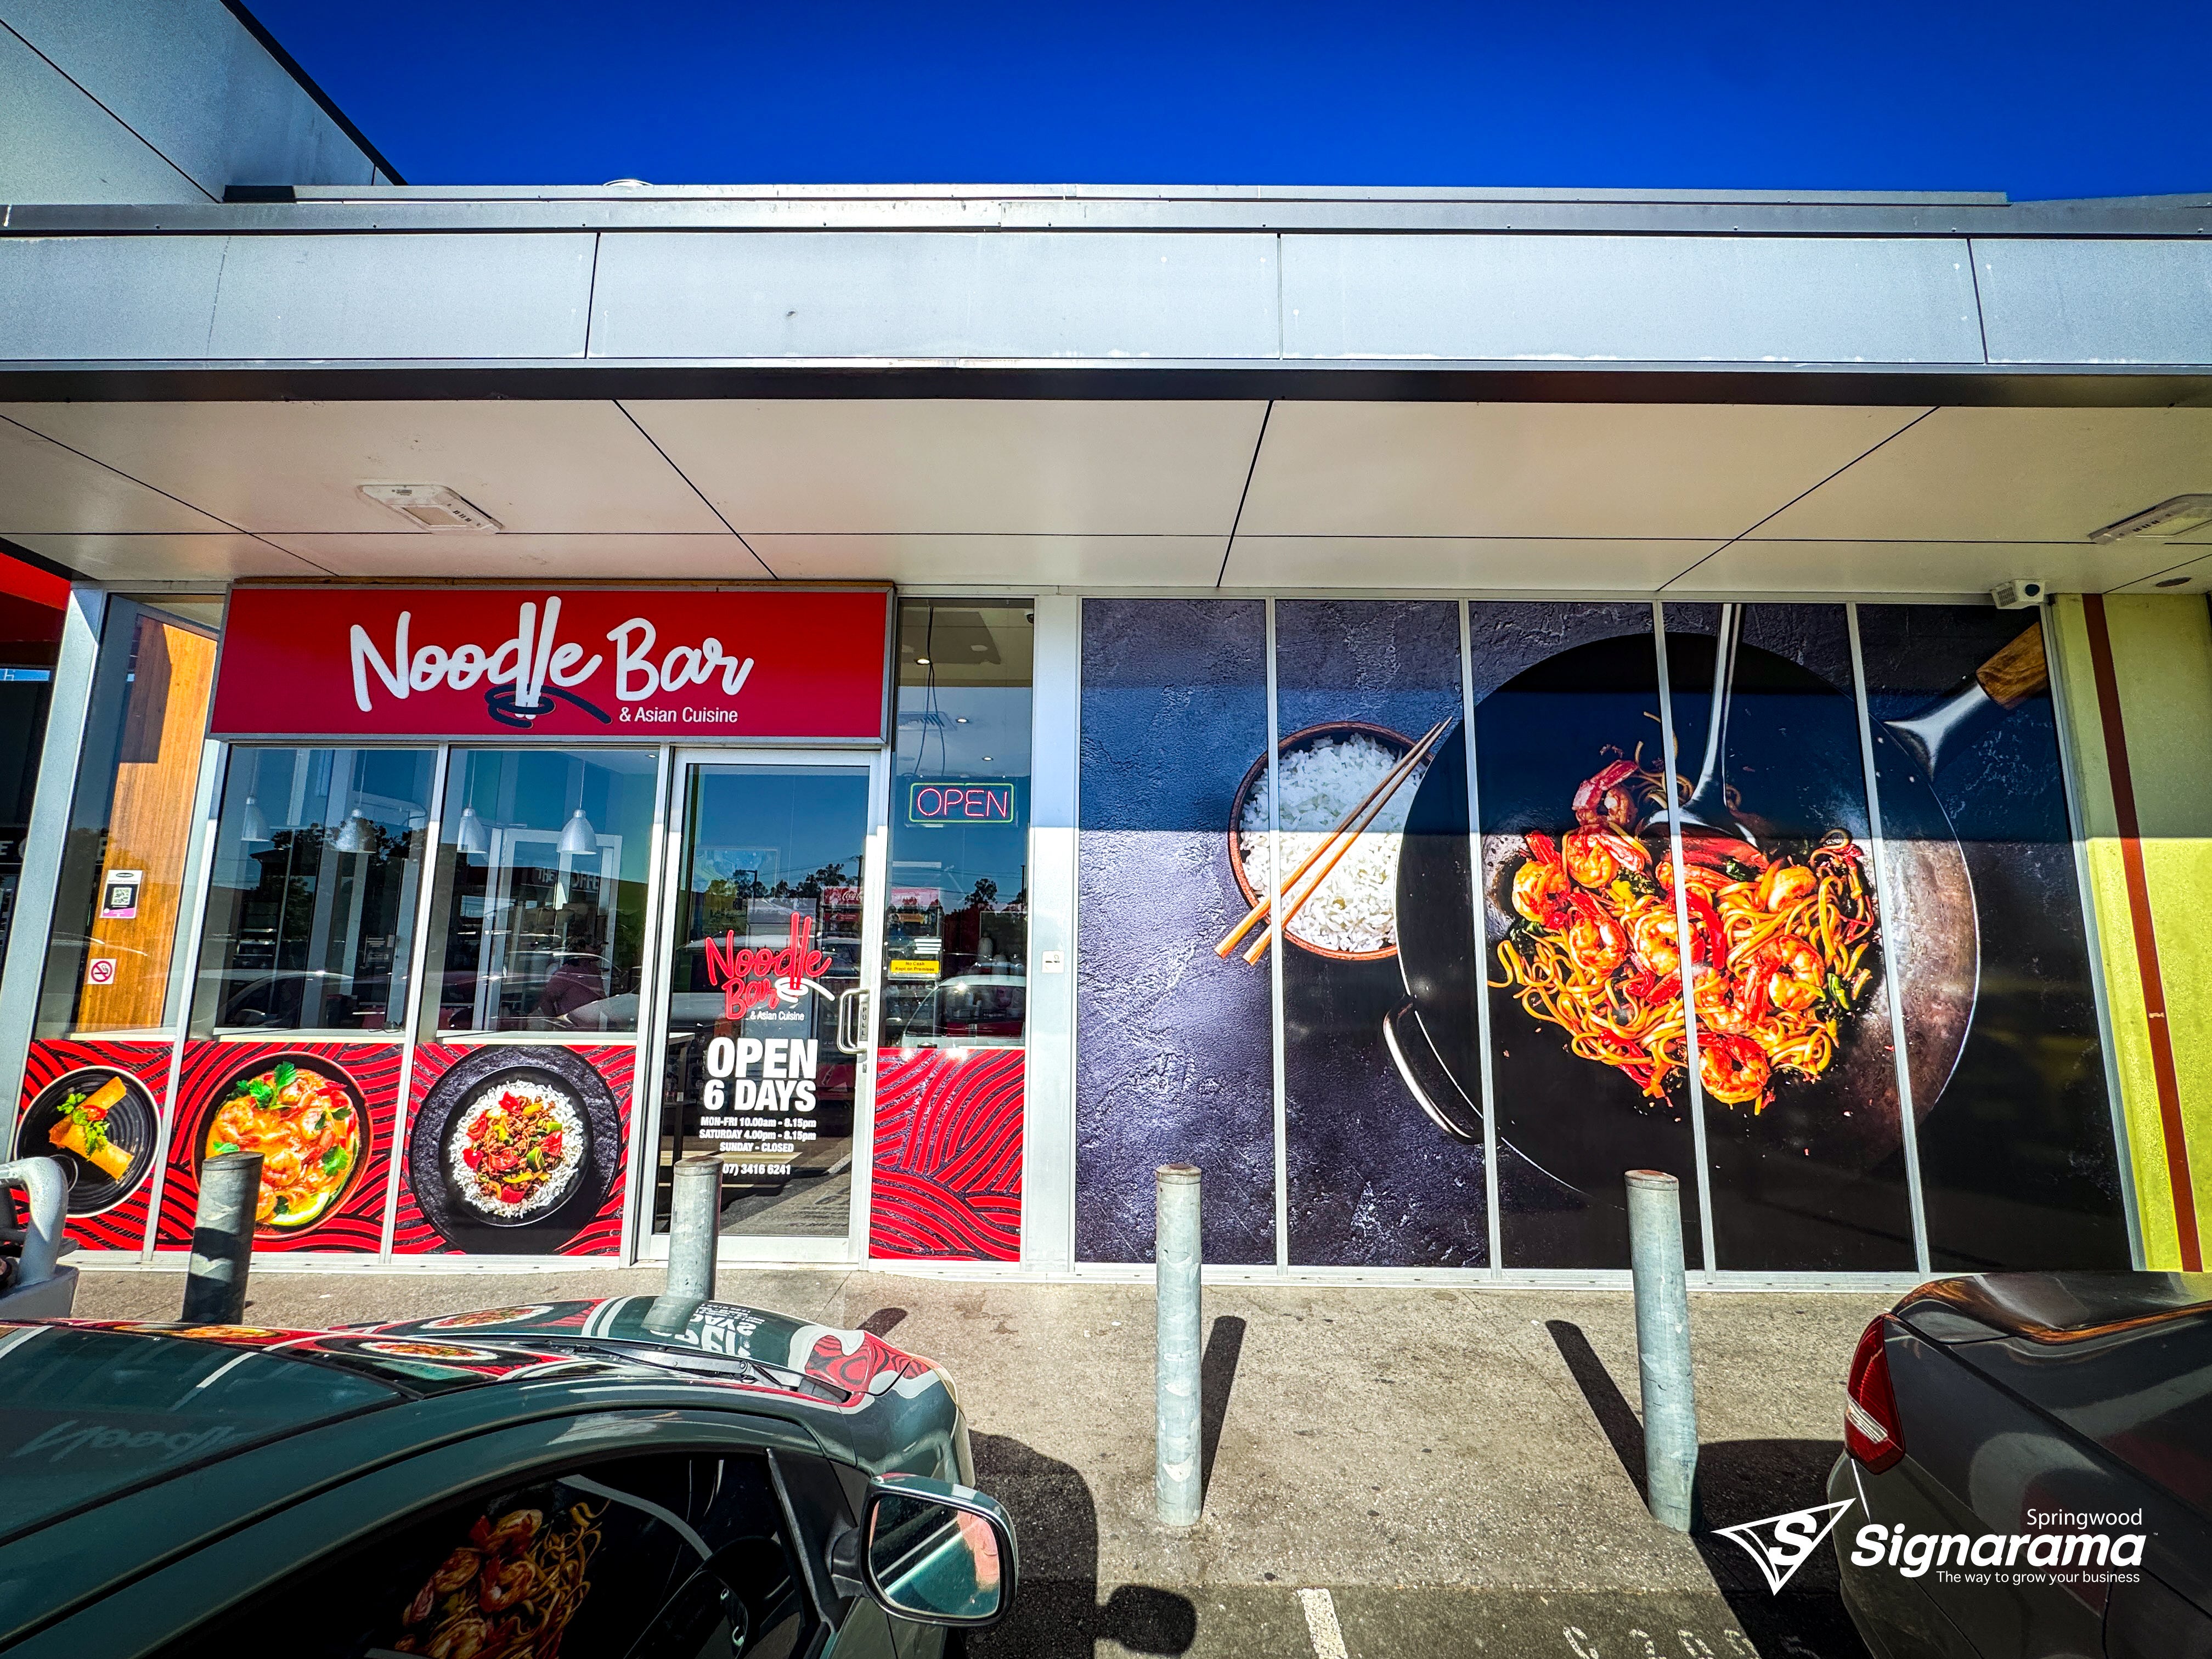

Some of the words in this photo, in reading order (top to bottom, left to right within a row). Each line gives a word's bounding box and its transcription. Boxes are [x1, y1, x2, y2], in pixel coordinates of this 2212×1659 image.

[350, 596, 603, 719] Noodle
[606, 617, 754, 701] Bar
[619, 708, 631, 722] &
[634, 707, 677, 723] Asian
[682, 707, 738, 723] Cuisine
[917, 788, 1008, 818] OPEN
[704, 911, 832, 989] Noodle
[721, 977, 780, 1020] Bar
[750, 1012, 757, 1020] &
[757, 1011, 777, 1020] Asian
[778, 1011, 805, 1021] Cuisine
[707, 1036, 819, 1079] OPEN
[704, 1079, 725, 1110] 6
[735, 1079, 816, 1112] DAYS
[701, 1116, 738, 1126] MON-FRI
[740, 1117, 777, 1127] 10.00am
[784, 1118, 817, 1129] 8.15pm
[699, 1129, 743, 1139] SATURDAY
[744, 1130, 776, 1141] 4.00pm
[783, 1131, 816, 1142] 8.15pm
[720, 1142, 754, 1152] SUNDAY
[761, 1143, 794, 1153] CLOSED
[722, 1164, 738, 1176] 07)
[741, 1164, 765, 1175] 3416
[767, 1164, 791, 1175] 6241
